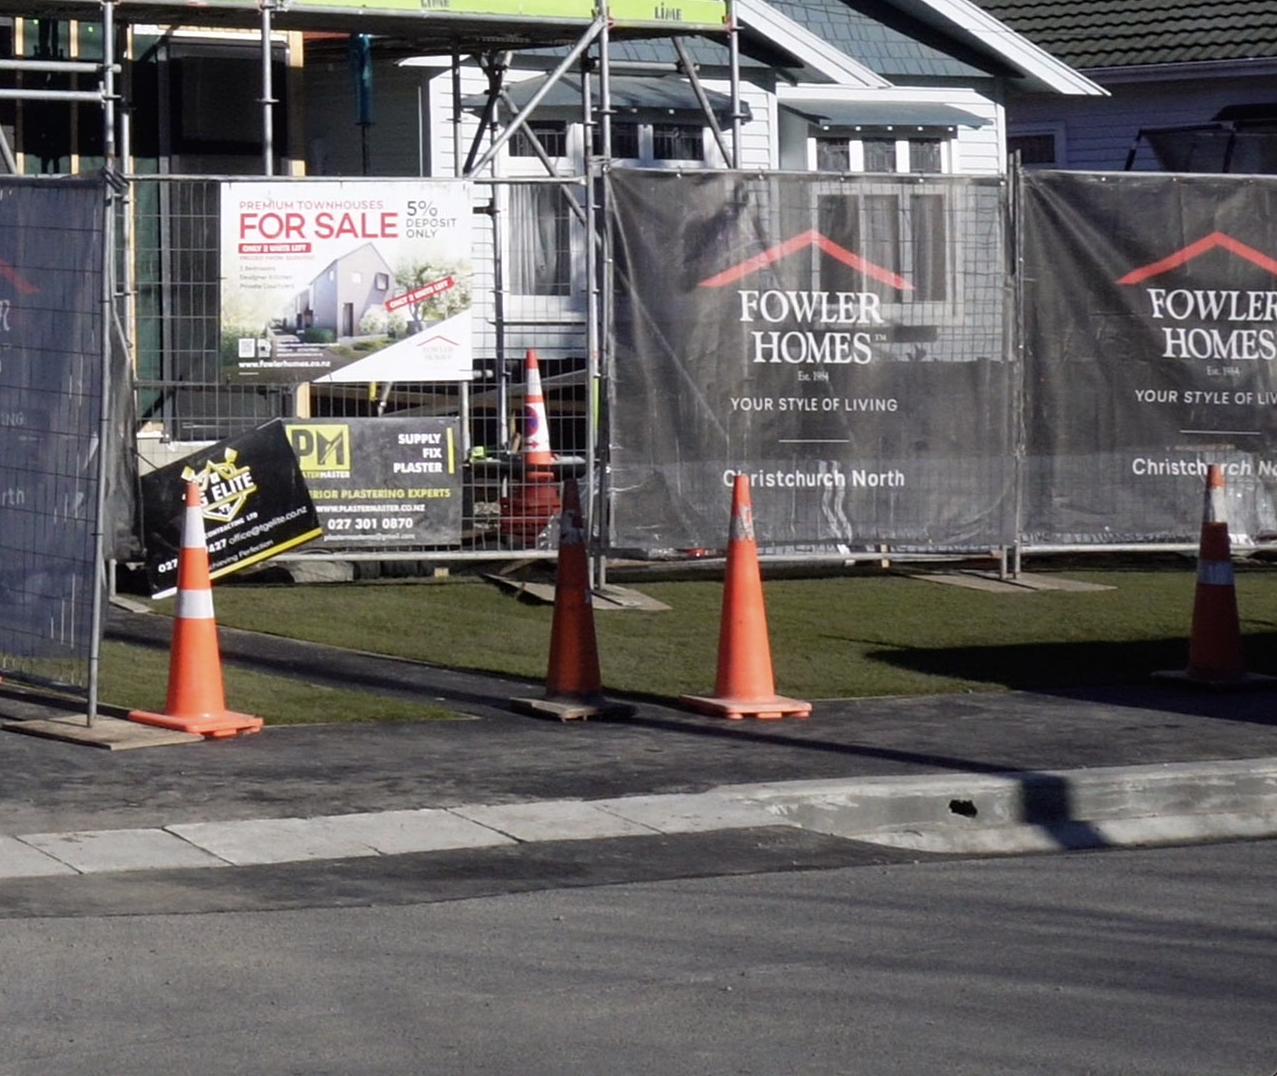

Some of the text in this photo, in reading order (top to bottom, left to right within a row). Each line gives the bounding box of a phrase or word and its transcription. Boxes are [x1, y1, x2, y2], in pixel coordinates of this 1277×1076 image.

[239, 200, 384, 210] PREMIUM TOWNHOUSES
[406, 200, 438, 217] 5%
[239, 212, 399, 239] FOR SALE
[406, 218, 457, 228] DEPOSIT
[406, 229, 438, 238] ONLY
[737, 290, 885, 324] FOWLER
[751, 331, 872, 364] HOMES
[1162, 327, 1277, 361] HOMES
[730, 397, 898, 412] YOUR STYLE OF LIVING
[1135, 389, 1178, 403] YOUR
[1184, 391, 1230, 404] STYLE
[1234, 392, 1253, 405] OF
[398, 433, 441, 444] SUPPLY
[422, 448, 442, 458] FIX
[393, 462, 443, 473] PLASTER
[1132, 458, 1251, 476] Christchrch
[852, 469, 905, 487] North
[211, 471, 254, 502] ELITE
[341, 489, 405, 499] PLASTERING
[408, 488, 451, 498] EXPERTS
[327, 518, 413, 530] 027 301 0870
